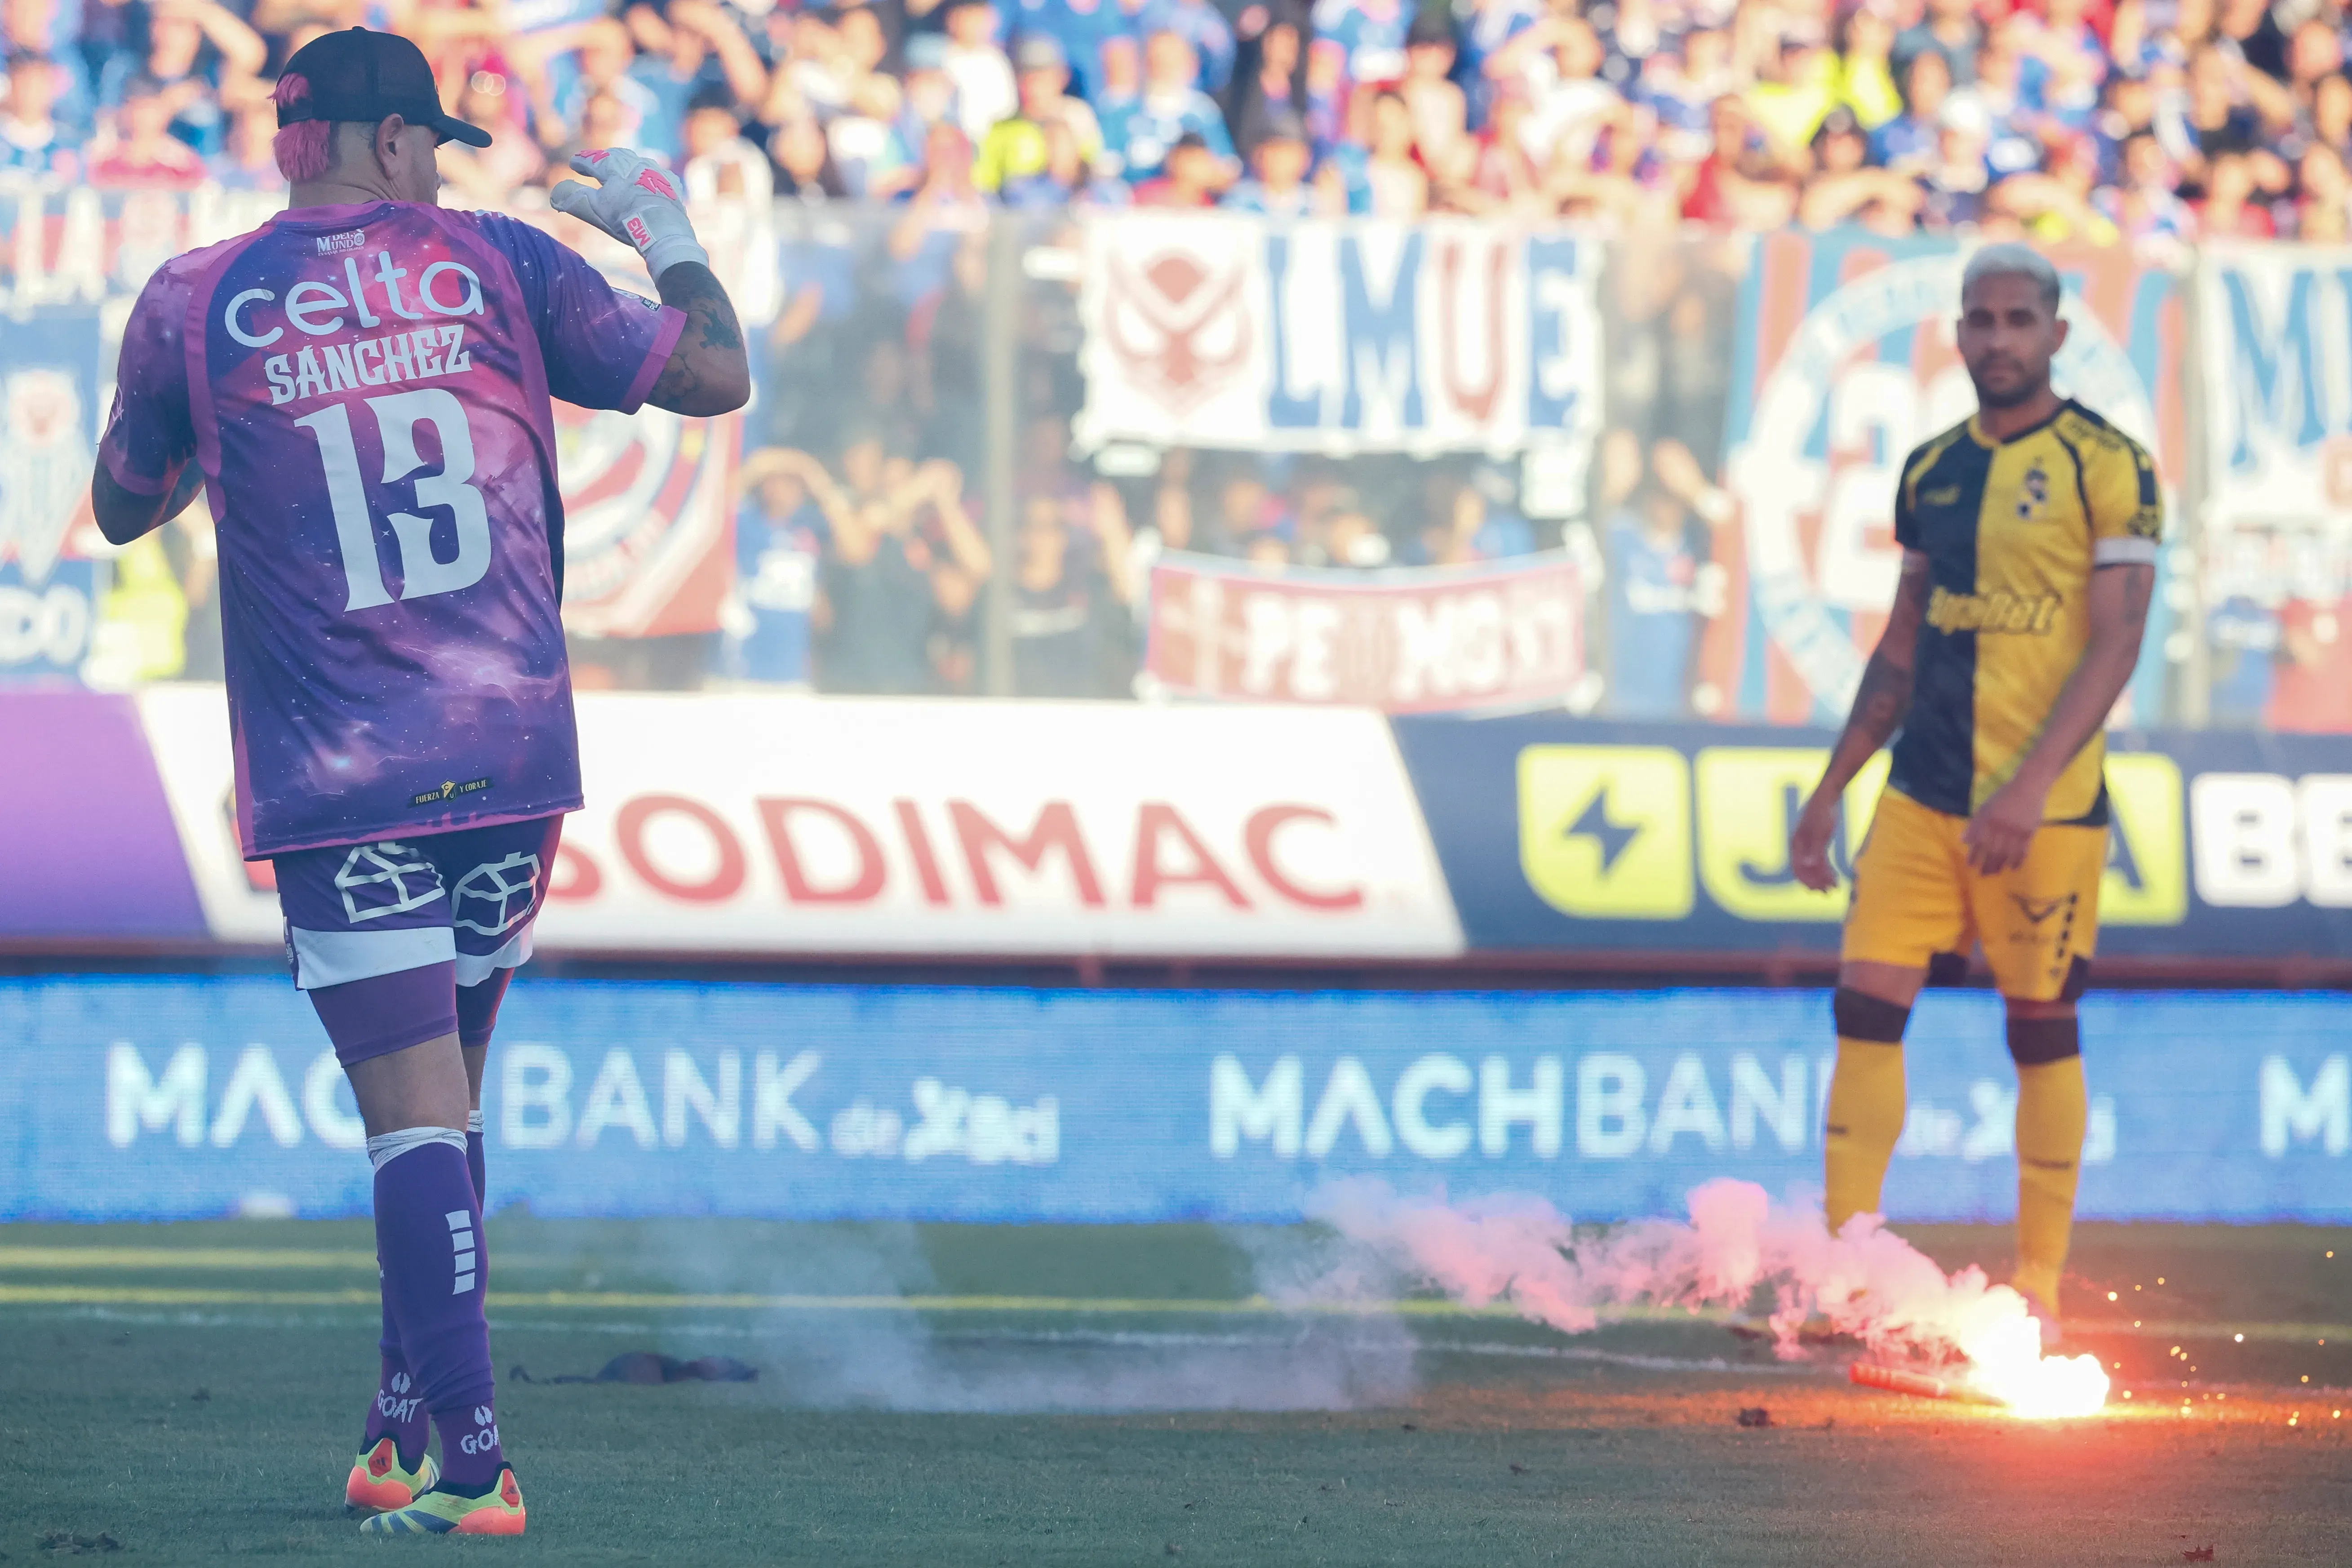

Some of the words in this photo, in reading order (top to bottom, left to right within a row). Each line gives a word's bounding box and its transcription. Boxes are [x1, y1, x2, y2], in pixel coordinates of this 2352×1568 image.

[316, 229, 365, 252] MUNDO
[332, 232, 354, 241] DEL
[627, 218, 651, 247] M13
[225, 250, 484, 347] celta
[265, 324, 471, 405] SÁNCHEZ
[294, 388, 491, 612] 13
[415, 791, 439, 804] FUERZA
[466, 779, 487, 792] CORAJE
[106, 1042, 821, 1153] MACBANK
[1210, 1053, 1836, 1159] MACHBAN
[377, 1389, 423, 1423] GOAT
[460, 1424, 499, 1454] GOA
